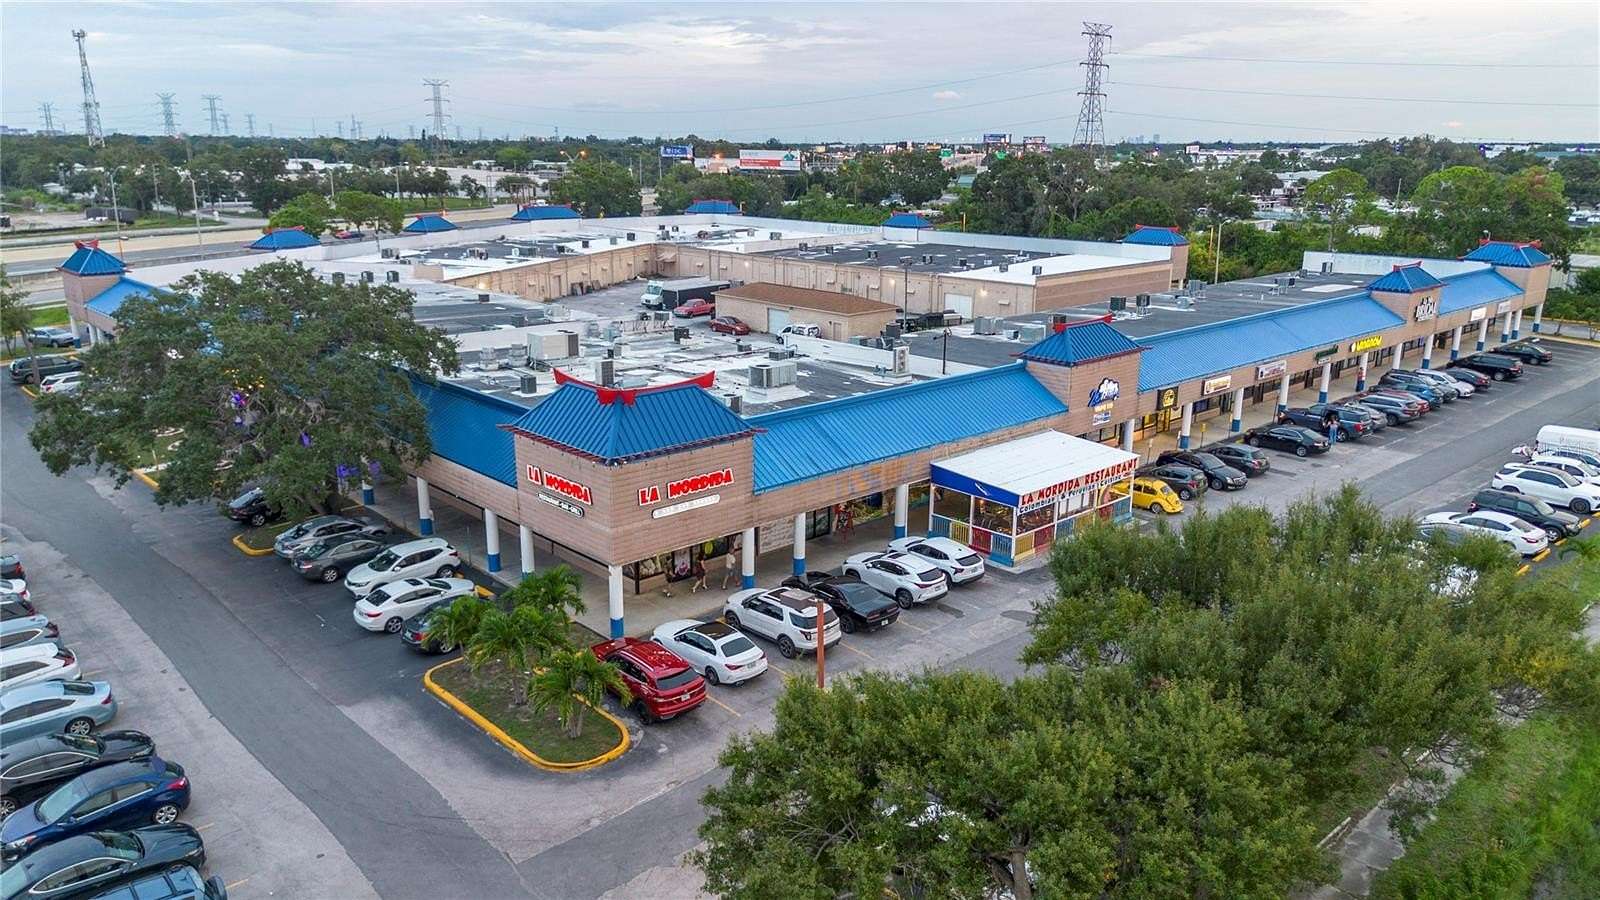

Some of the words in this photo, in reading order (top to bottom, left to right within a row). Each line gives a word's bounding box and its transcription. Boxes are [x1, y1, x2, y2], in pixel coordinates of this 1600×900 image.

[527, 464, 541, 485] LA
[544, 471, 592, 505] MORDIDA
[638, 486, 661, 506] LA
[668, 469, 734, 499] MORDIDA
[1019, 497, 1055, 514] Colombian
[1068, 484, 1096, 498] Peruvian
[1100, 474, 1122, 487] Cuisine
[1021, 495, 1034, 505] LA
[1037, 478, 1080, 500] MORDIDA
[1084, 458, 1138, 485] RESTAURANT
